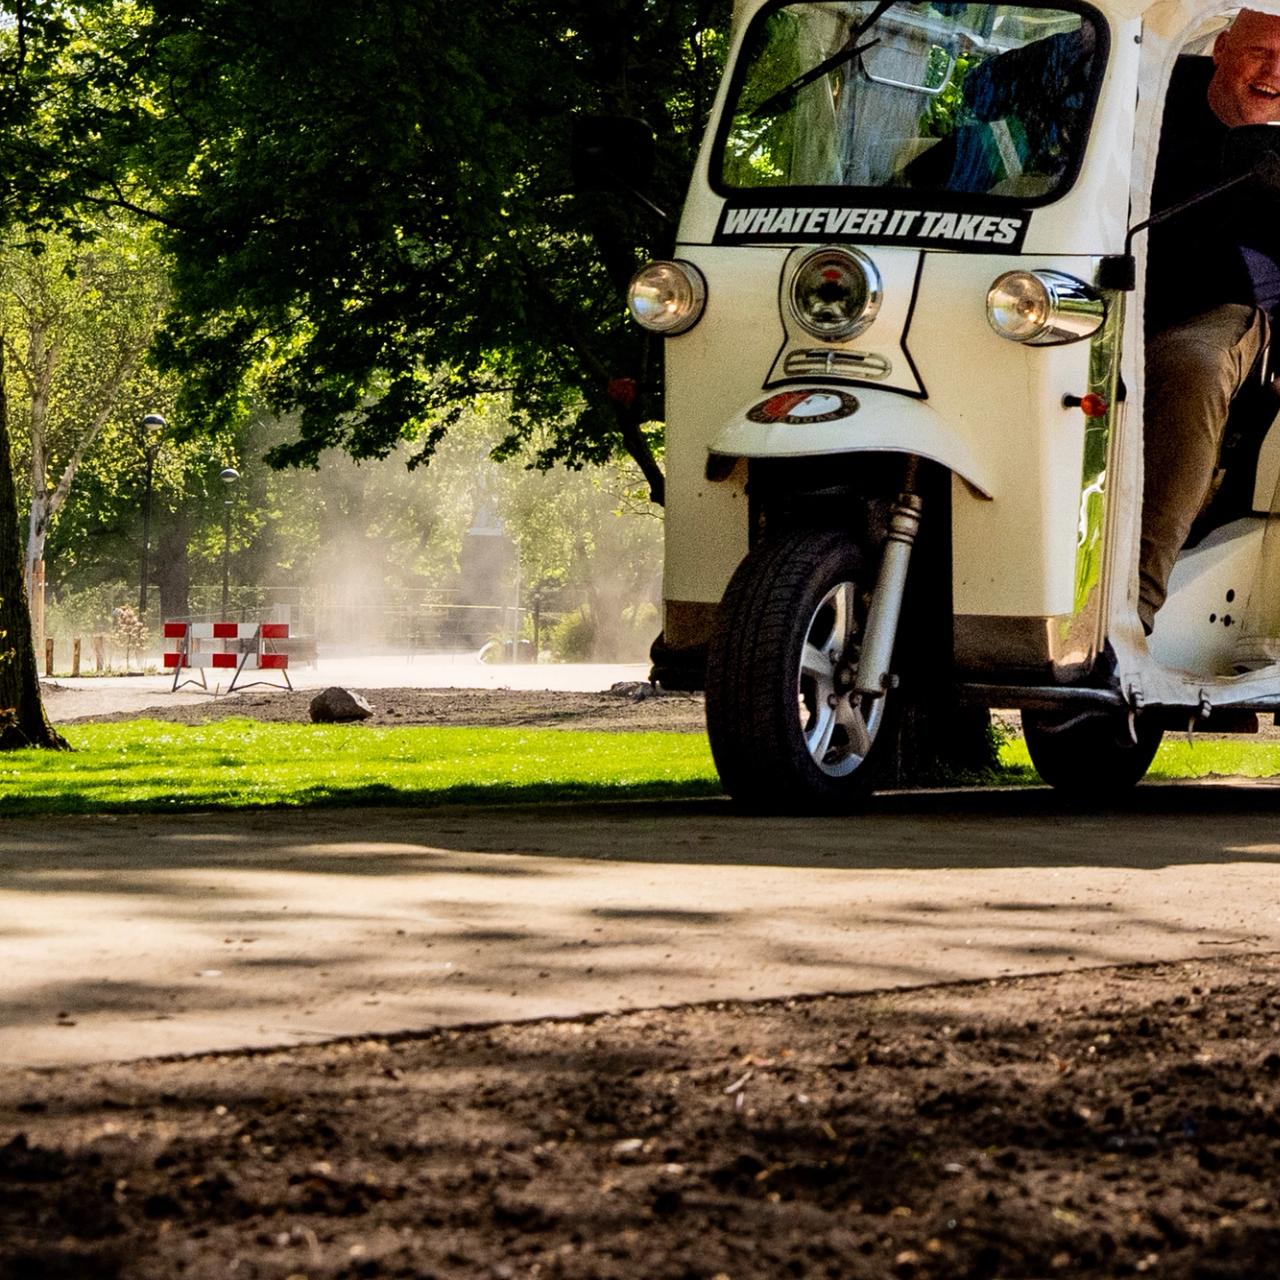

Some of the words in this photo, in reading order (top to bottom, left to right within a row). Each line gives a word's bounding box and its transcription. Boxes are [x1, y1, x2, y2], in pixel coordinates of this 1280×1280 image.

[722, 207, 889, 235] WHATEVER
[883, 210, 921, 237] IT
[917, 211, 1023, 244] TAKES
